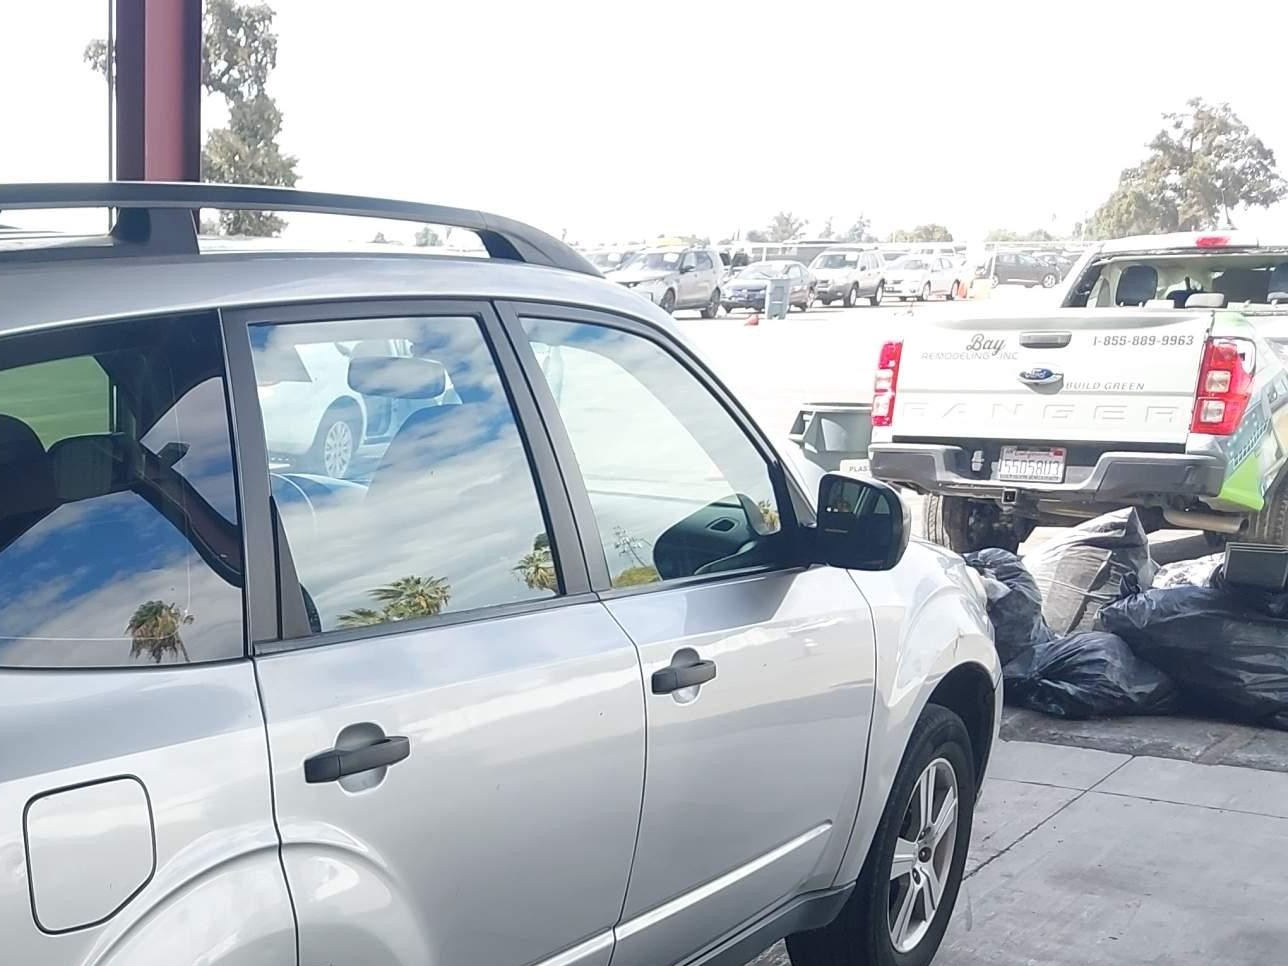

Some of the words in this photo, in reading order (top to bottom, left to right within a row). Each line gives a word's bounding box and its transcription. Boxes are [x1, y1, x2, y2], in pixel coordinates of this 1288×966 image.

[966, 333, 1007, 355] Bay
[1093, 335, 1194, 346] 1-855-889-9963
[921, 352, 990, 361] REMODELING
[1065, 382, 1100, 391] BUILD
[1104, 382, 1145, 391] GREEN
[901, 402, 1182, 425] RANGER
